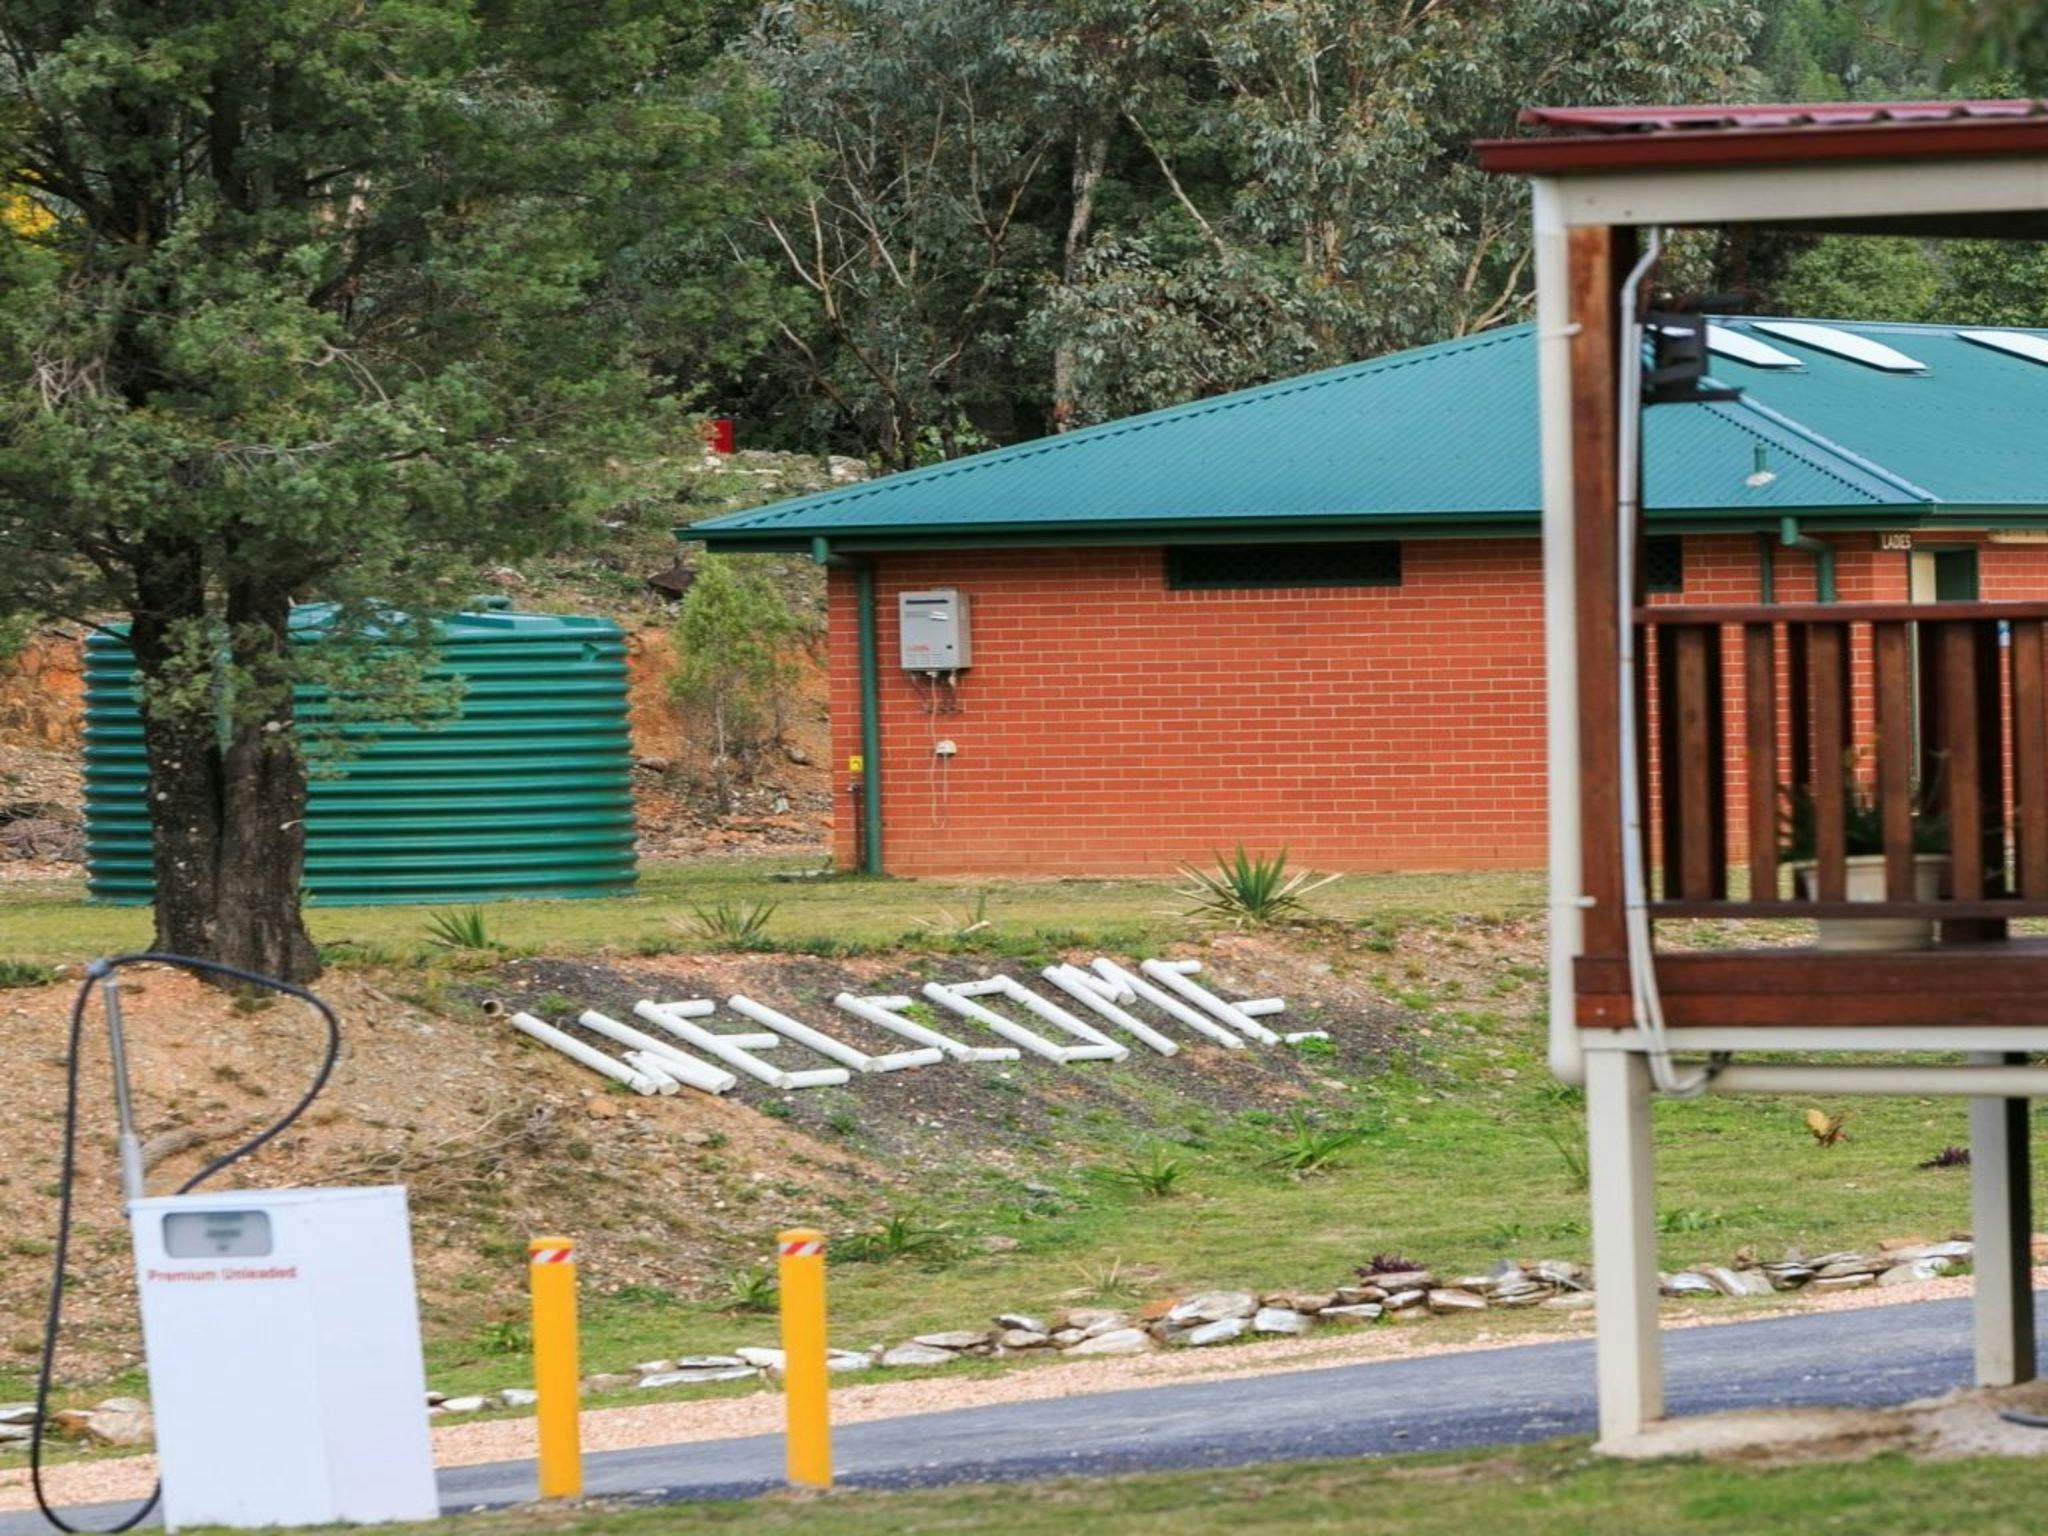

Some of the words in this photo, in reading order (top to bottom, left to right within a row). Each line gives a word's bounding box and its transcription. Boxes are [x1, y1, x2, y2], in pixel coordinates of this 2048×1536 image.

[511, 957, 1329, 1095] WELCOME
[147, 1268, 216, 1281] Premium
[222, 1266, 297, 1280] Unleaded
